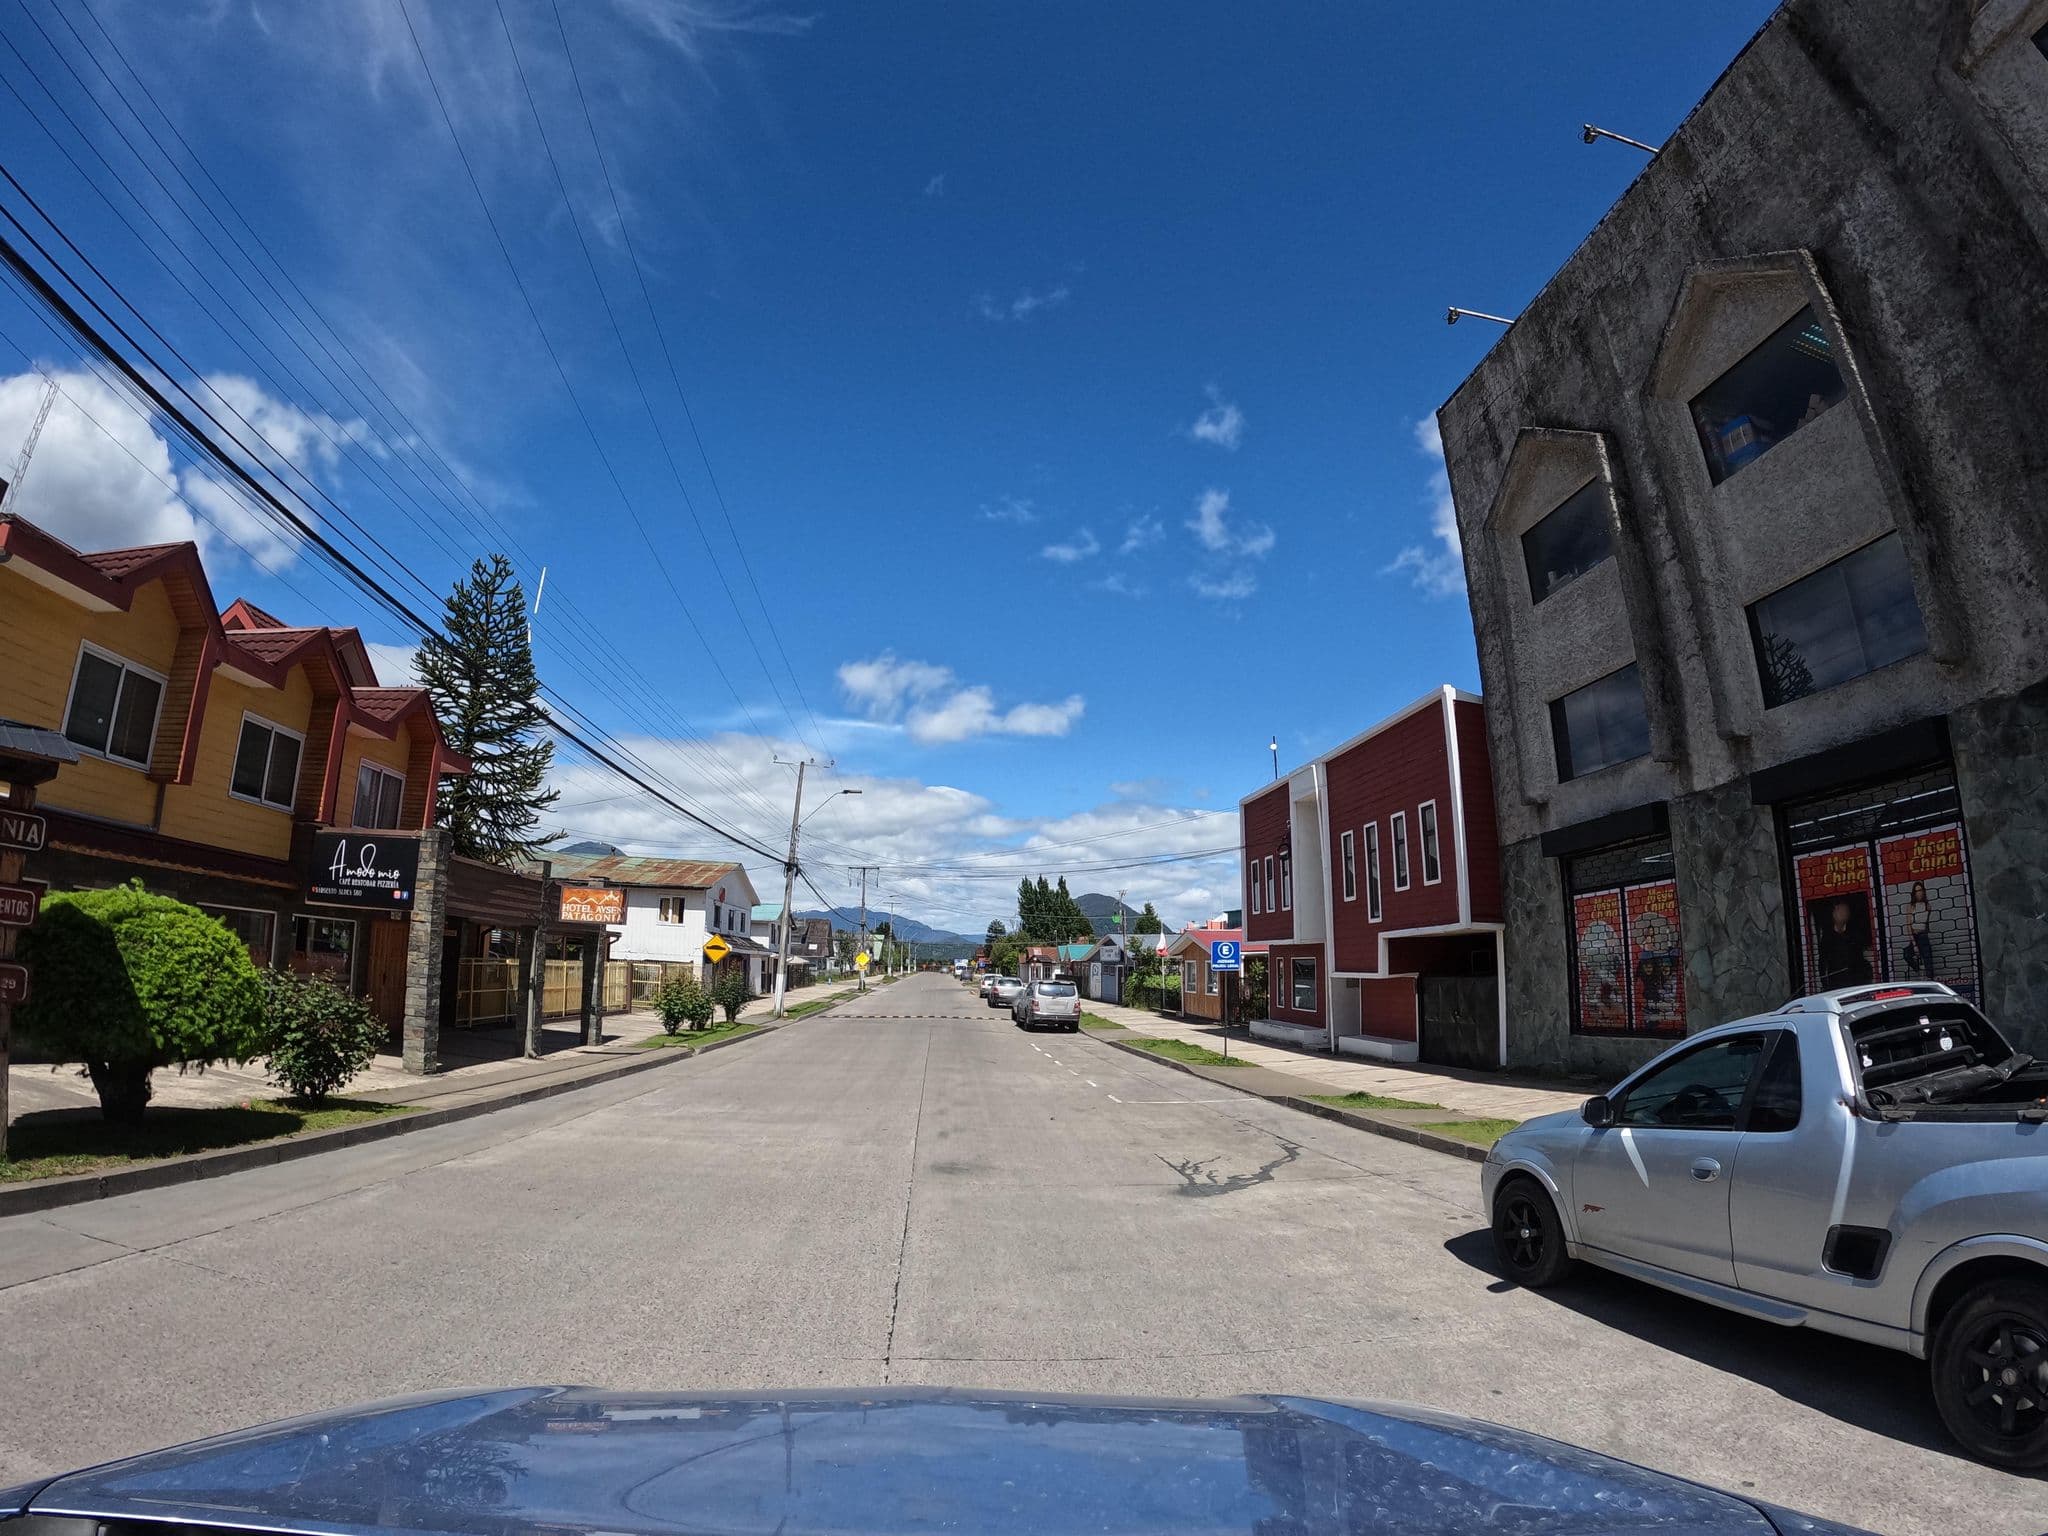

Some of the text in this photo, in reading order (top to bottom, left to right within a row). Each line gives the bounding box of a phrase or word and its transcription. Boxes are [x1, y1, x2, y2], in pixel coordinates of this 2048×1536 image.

[1913, 836, 1956, 857] Mega
[1826, 855, 1865, 873] Mega
[1908, 852, 1958, 874] China
[377, 870, 400, 880] mio
[1823, 869, 1867, 888] China
[562, 903, 591, 913] HOTEL
[1222, 945, 1230, 955] E
